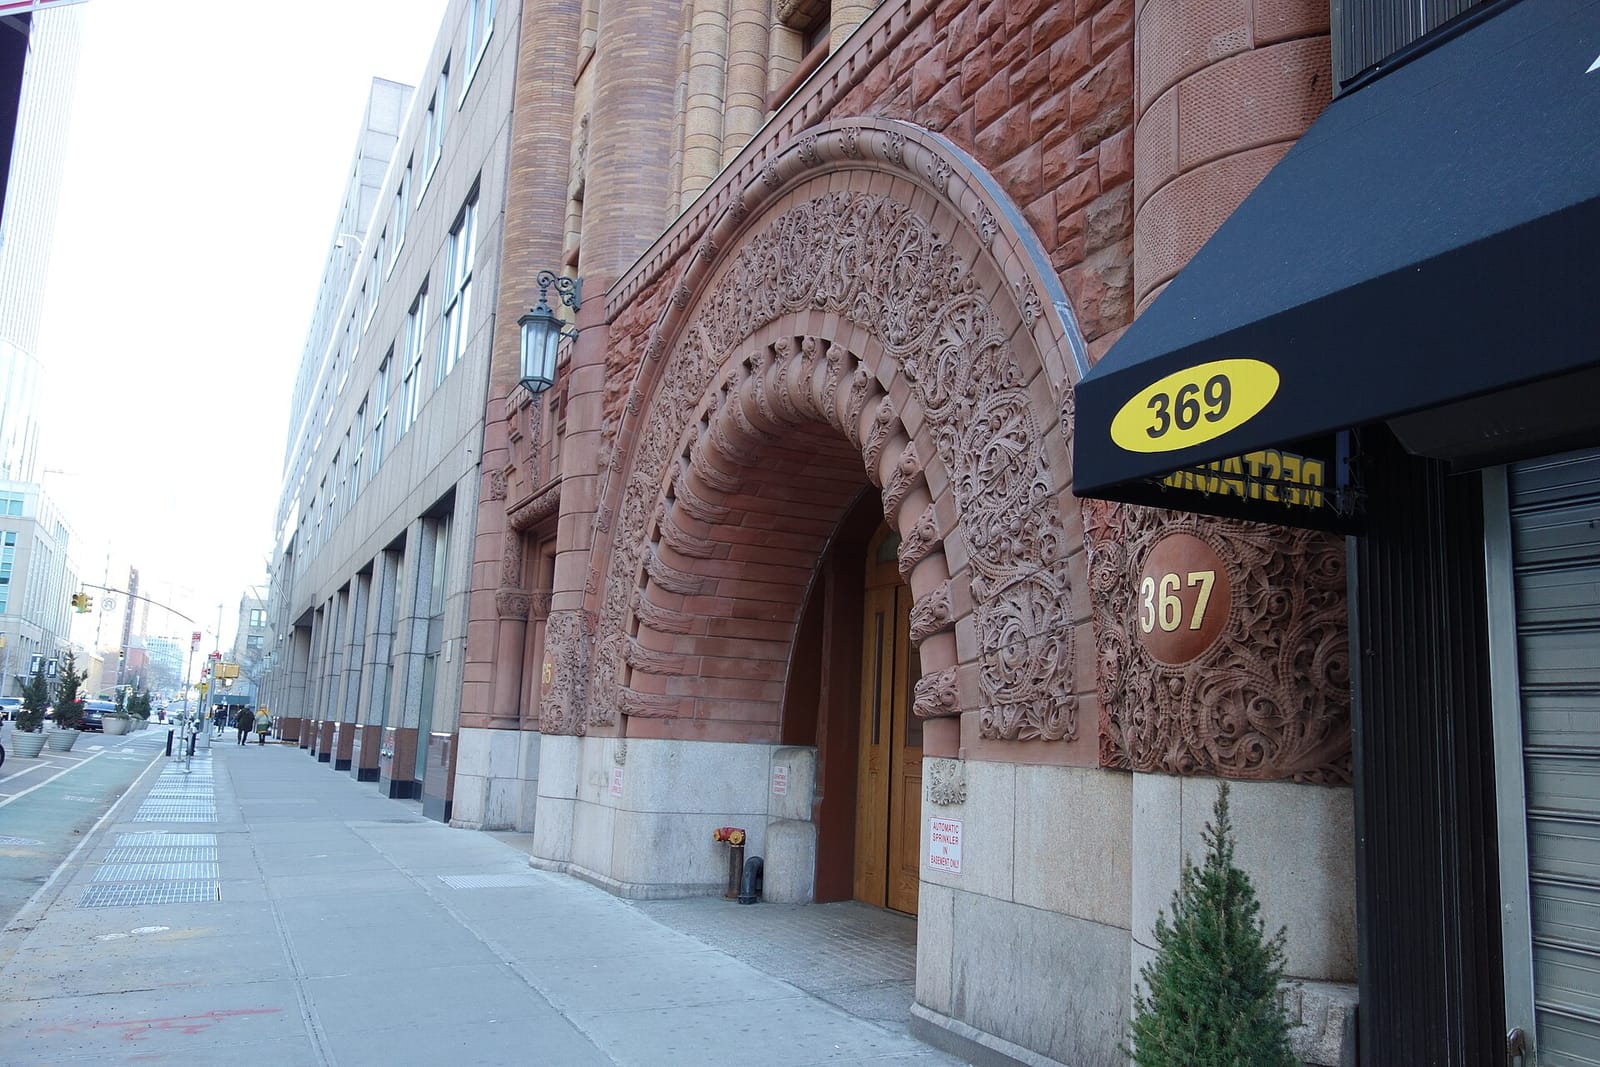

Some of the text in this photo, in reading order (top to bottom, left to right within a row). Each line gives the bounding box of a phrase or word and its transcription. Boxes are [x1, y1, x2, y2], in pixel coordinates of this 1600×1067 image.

[1146, 374, 1232, 439] 369
[1141, 570, 1216, 633] 367
[933, 822, 959, 834] AUTOMATIC
[933, 833, 959, 845] SPRINKLER
[943, 846, 948, 855] IN
[930, 855, 960, 869] BASEMENT ONLY
